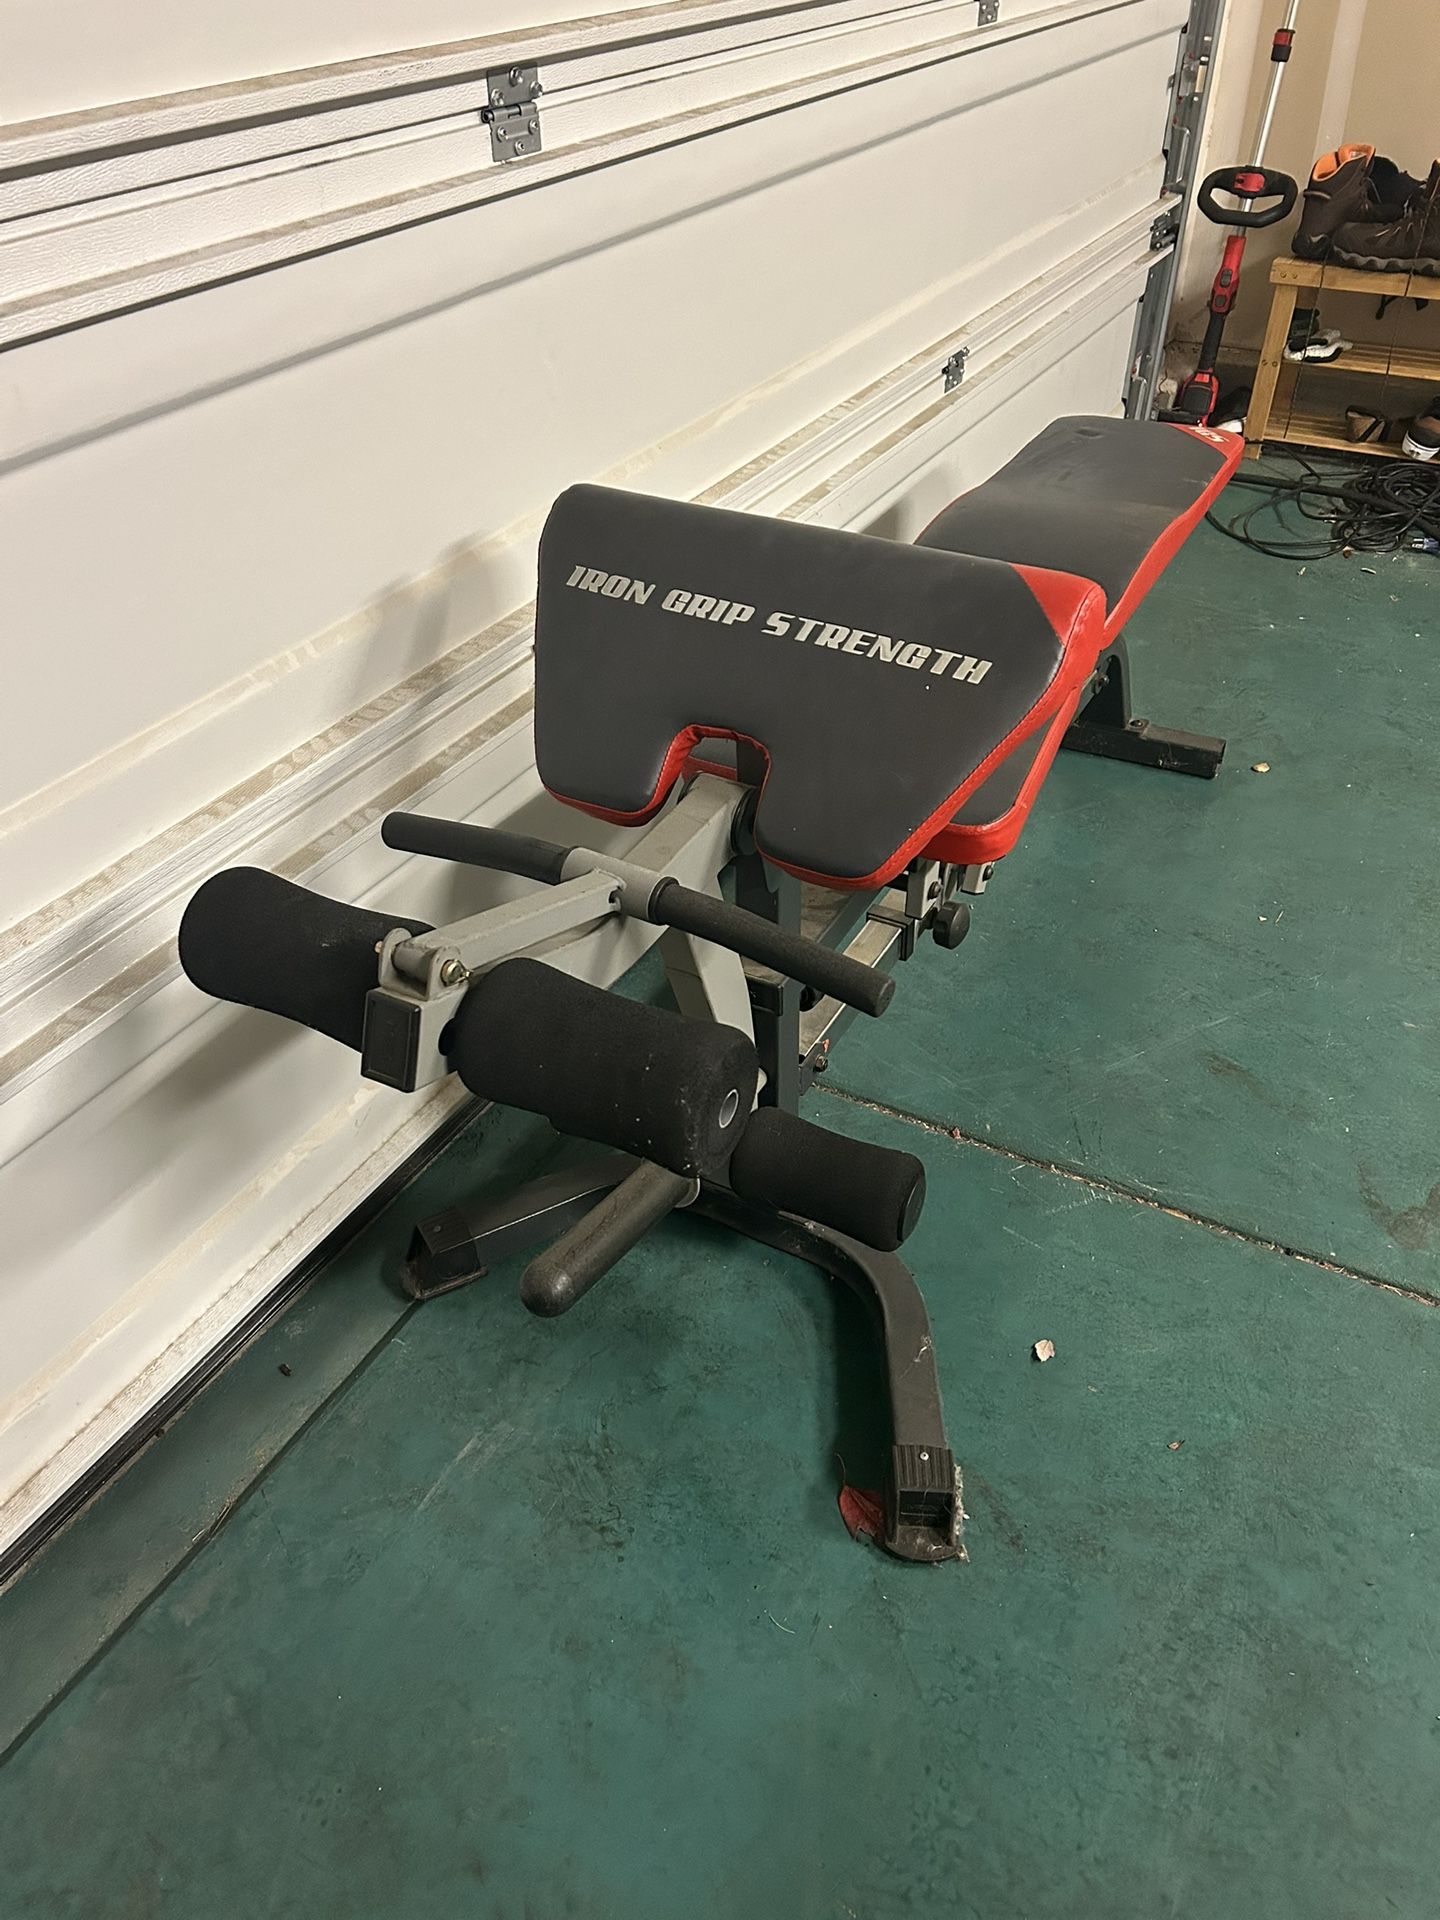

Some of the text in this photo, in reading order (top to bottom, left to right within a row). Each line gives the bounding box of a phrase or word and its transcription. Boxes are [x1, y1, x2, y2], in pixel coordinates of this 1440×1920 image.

[566, 565, 993, 686] IRON GRIP STRENGTH
